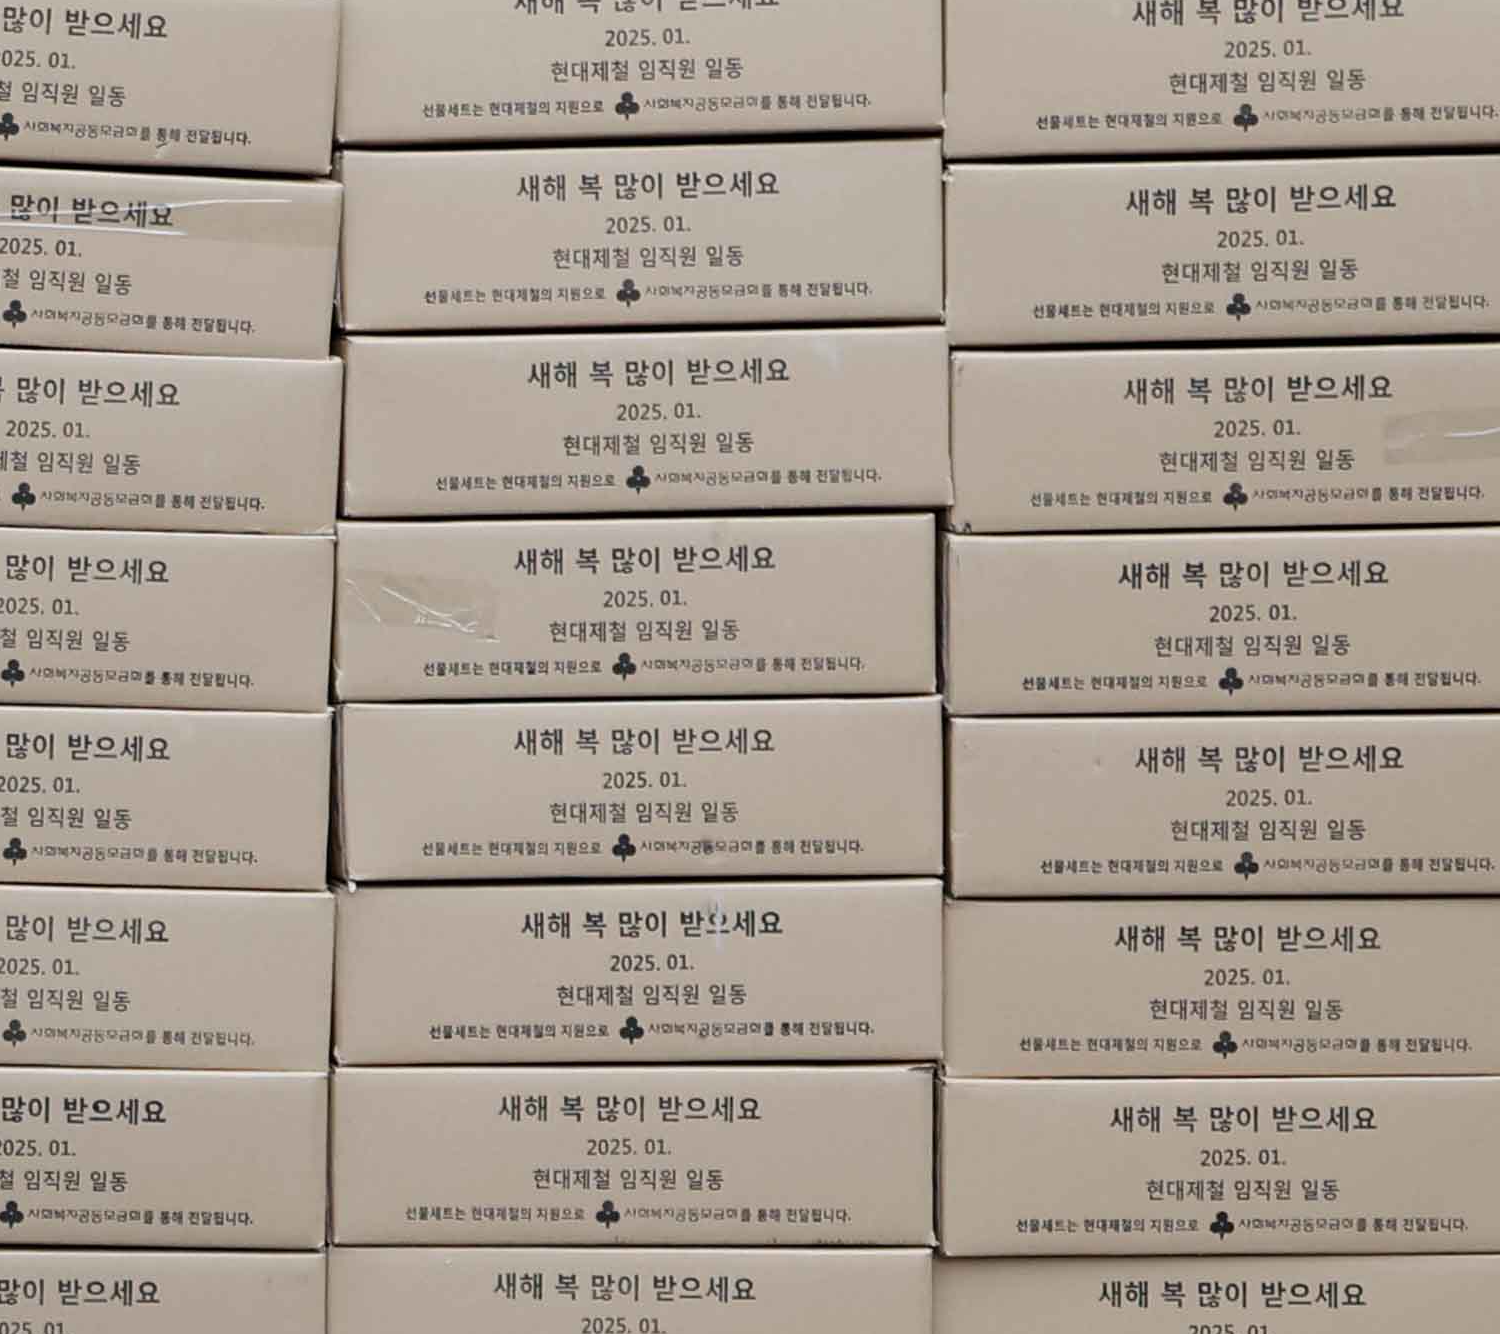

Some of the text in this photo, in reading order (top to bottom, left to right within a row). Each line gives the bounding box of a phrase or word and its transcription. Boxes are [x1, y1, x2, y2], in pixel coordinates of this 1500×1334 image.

[17, 376, 65, 405] 많이
[78, 379, 180, 408] 받으세요
[5, 419, 90, 440] 2025. 01.
[36, 448, 93, 474] 임직원
[103, 453, 140, 476] 일동
[170, 494, 195, 510] 통해
[199, 495, 265, 512] 전달됩니다.
[1118, 559, 1388, 590] 새해 복 많이 받으세요
[1209, 603, 1297, 623] 2025. 01.
[1154, 635, 1351, 658] 현대제철 임직원 일동
[1022, 676, 1084, 691] 선물세트는
[1090, 675, 1153, 691] 현대제철의
[1158, 675, 1208, 690] 지원으로
[1383, 672, 1409, 687] 통해
[1414, 671, 1481, 687] 전달됩니다.
[494, 1271, 756, 1304] 새해 복 많이 받으세요
[581, 1316, 667, 1334] 2025. 01.
